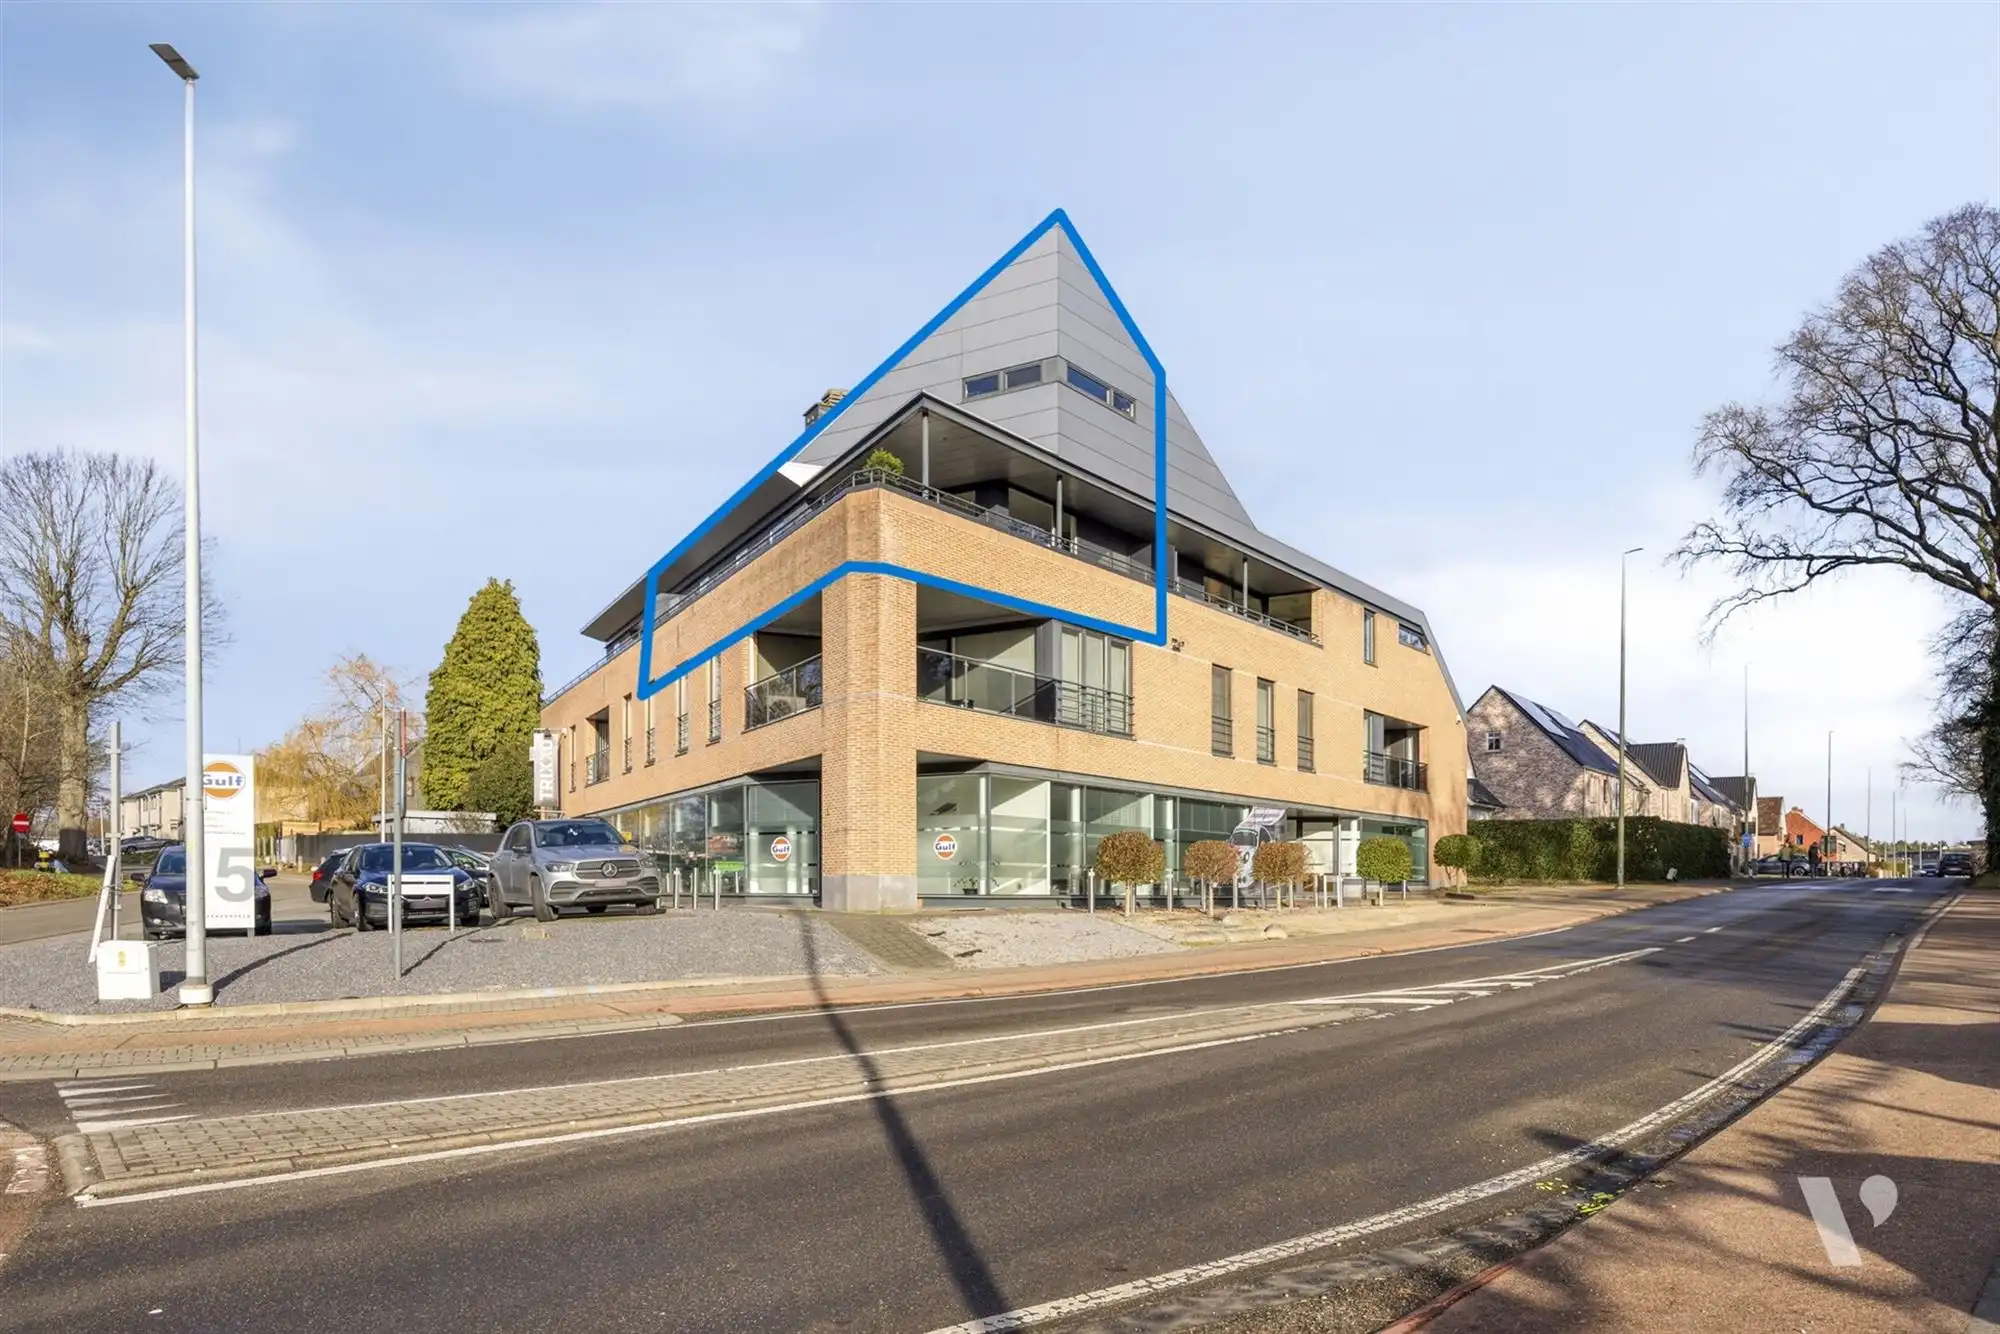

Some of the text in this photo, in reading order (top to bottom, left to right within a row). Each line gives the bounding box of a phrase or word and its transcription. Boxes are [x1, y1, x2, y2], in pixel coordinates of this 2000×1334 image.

[203, 773, 243, 787] Gulf
[772, 845, 790, 853] Gulf
[935, 842, 956, 851] Gulf
[214, 847, 255, 902] 5
